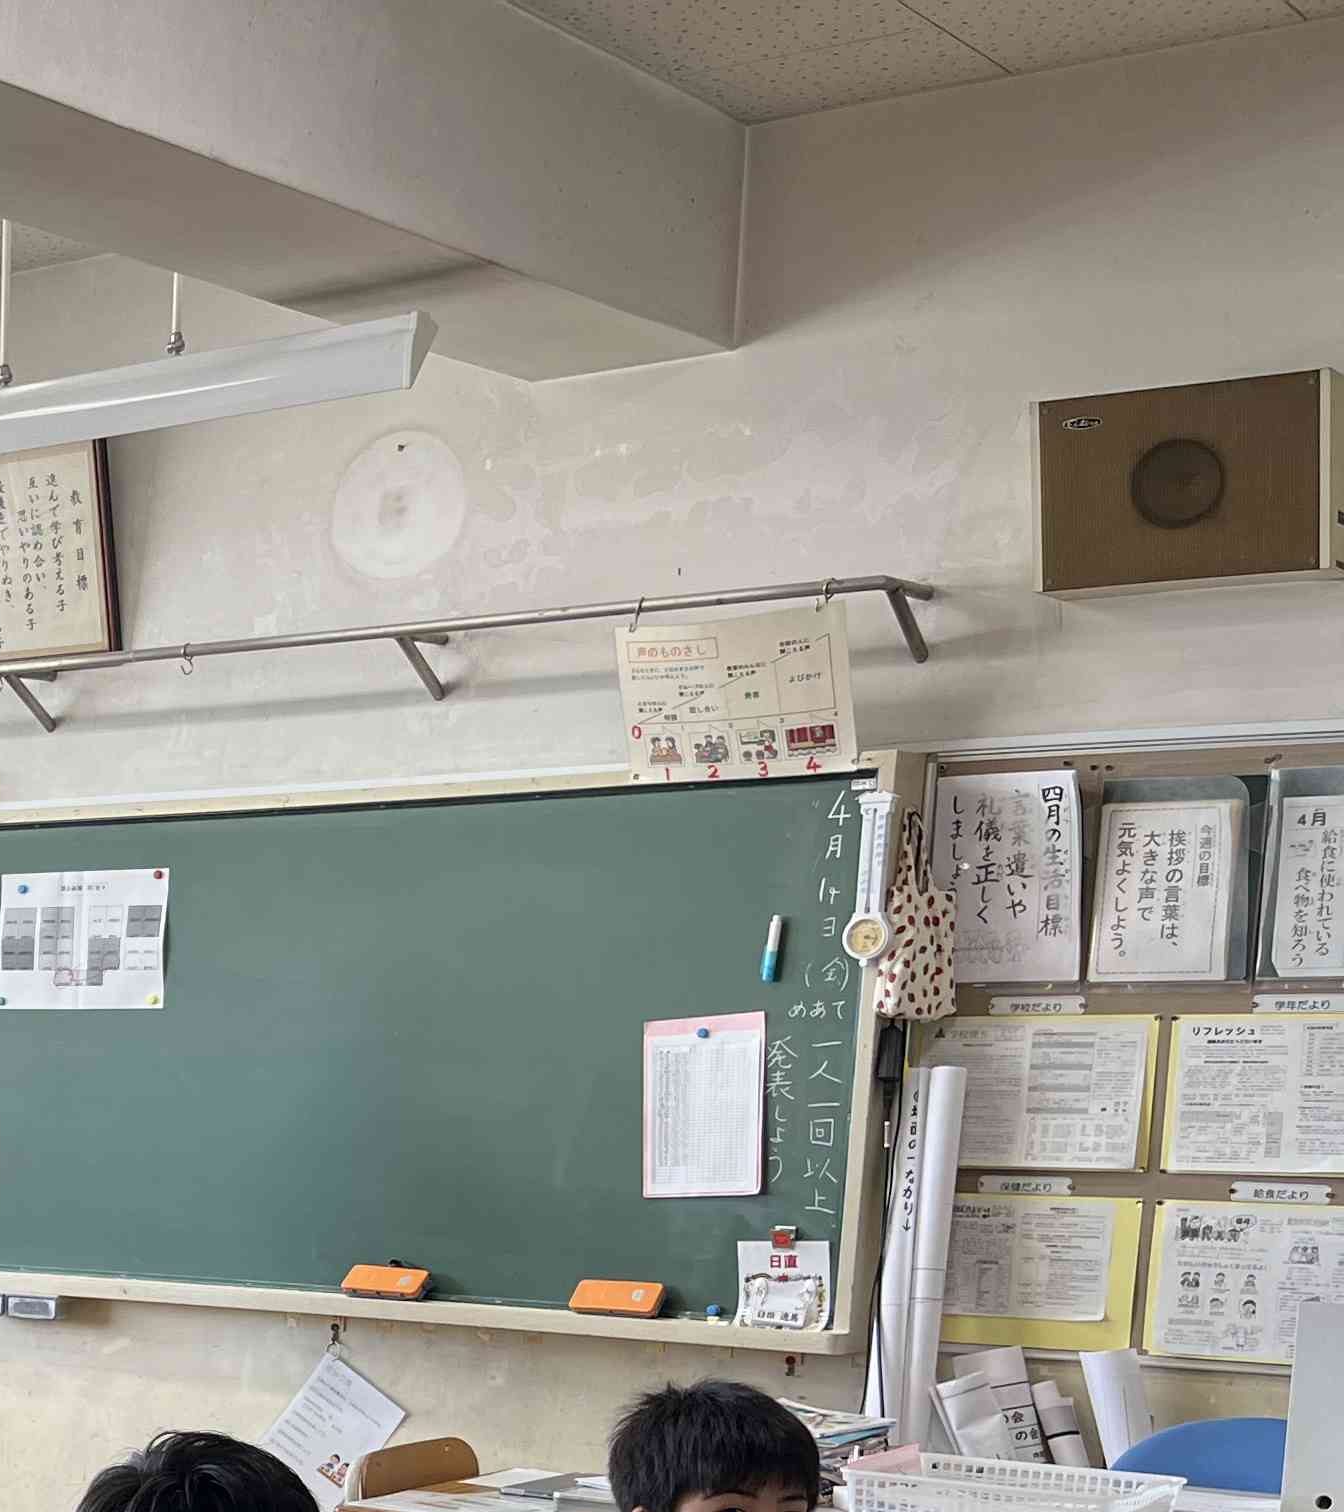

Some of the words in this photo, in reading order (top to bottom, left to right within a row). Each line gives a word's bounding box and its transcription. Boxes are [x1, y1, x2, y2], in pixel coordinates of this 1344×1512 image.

[44, 472, 68, 613] 進んで学び考える子
[70, 489, 89, 592] 教育目標
[16, 508, 38, 632] 思いやりのある子
[637, 645, 707, 658] 声のものさし
[631, 725, 642, 740] 0
[664, 767, 671, 781] 1
[707, 764, 720, 779] 2
[757, 761, 769, 777] 3
[806, 756, 822, 772] 4
[1296, 809, 1327, 828] 4月
[971, 793, 1002, 925] 礼儀を正しく
[1004, 788, 1033, 919] 言葉遣いや
[1037, 785, 1065, 938] 四月の生活目標
[1196, 824, 1212, 888] 今週の目標
[1110, 822, 1137, 958] 元気よくしよう。
[1137, 830, 1161, 922] 大きな声で
[1160, 829, 1187, 947] 挨拶の言葉は、
[1315, 829, 1339, 957] 給食に使われている
[1290, 867, 1312, 967] 食べ物を知ろう
[787, 1000, 847, 1020] めあて
[1009, 1002, 1063, 1013] 学校だより
[1274, 999, 1331, 1011] 学年だより
[1191, 1026, 1256, 1037] リフレッシュ
[766, 1035, 799, 1183] 発表しよう
[802, 1040, 843, 1215] 一人一回以上
[999, 1181, 1053, 1193] 保健だより
[1252, 1188, 1310, 1201] 給食だより
[769, 1254, 799, 1269] 日直
